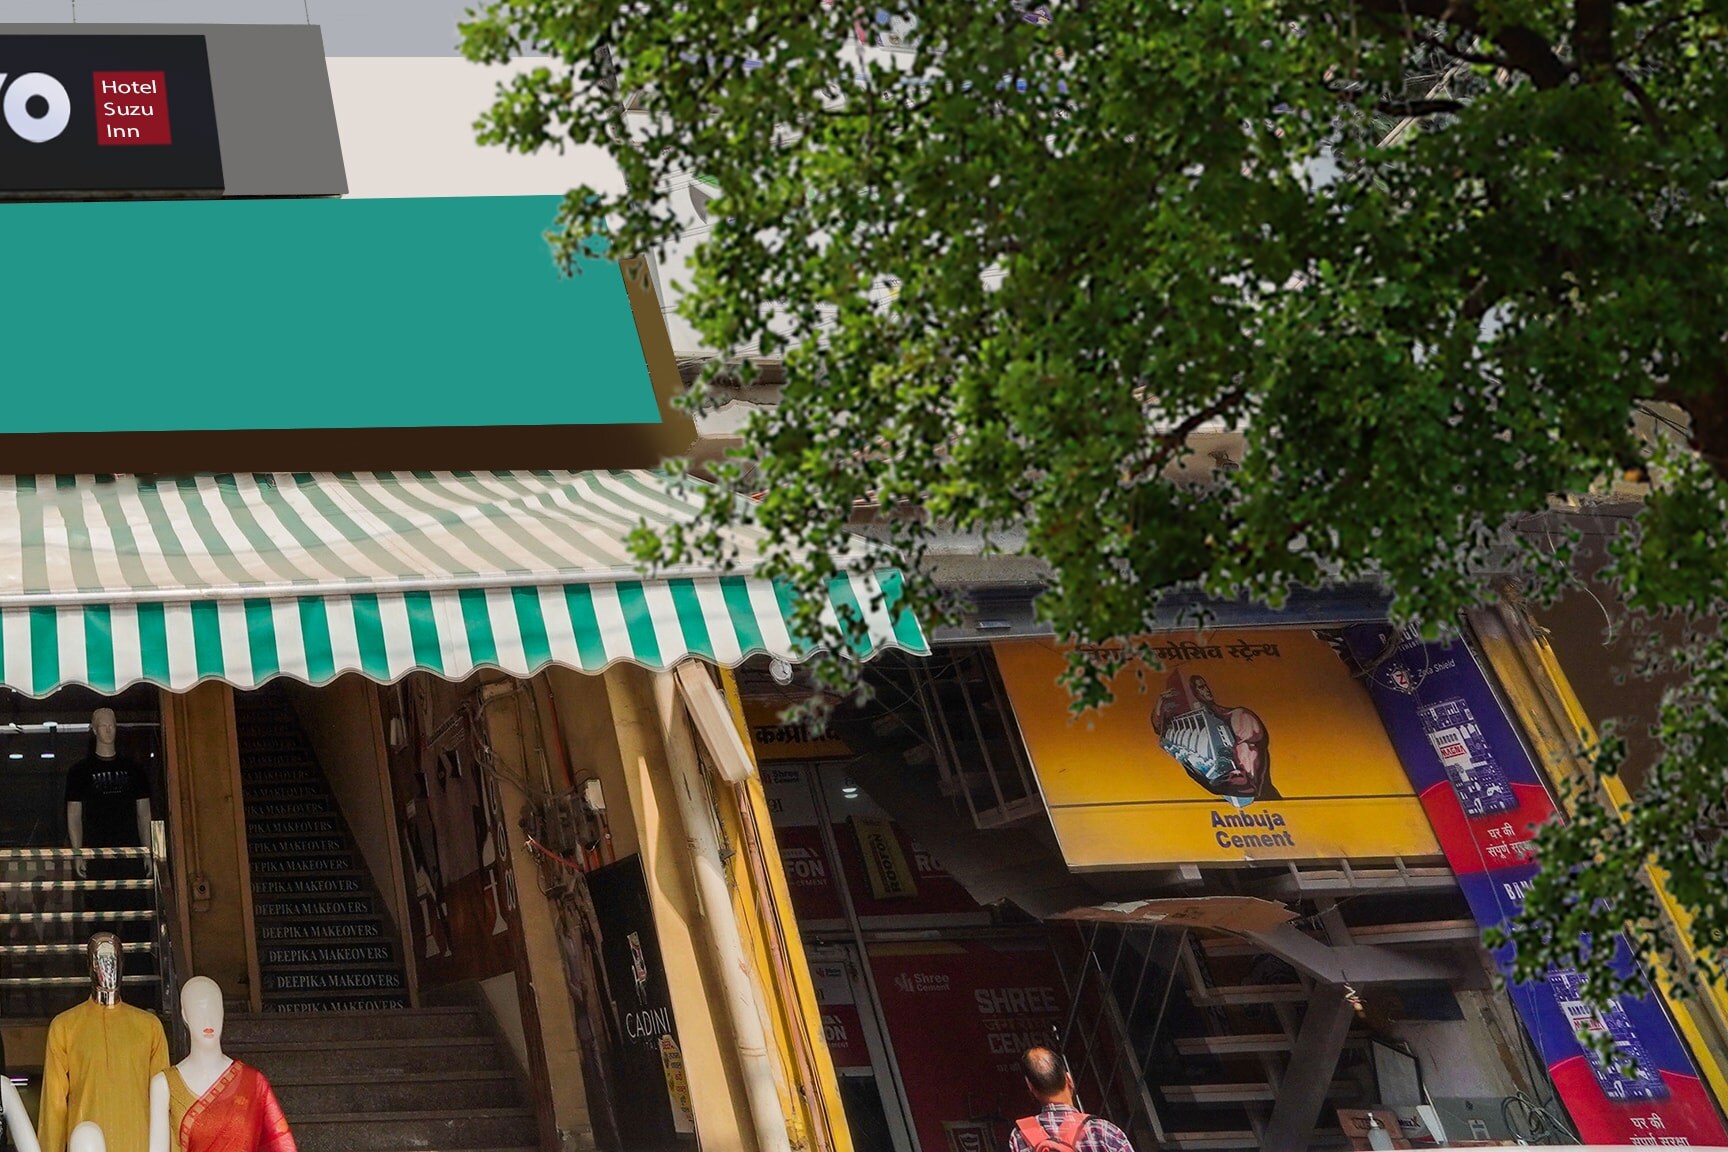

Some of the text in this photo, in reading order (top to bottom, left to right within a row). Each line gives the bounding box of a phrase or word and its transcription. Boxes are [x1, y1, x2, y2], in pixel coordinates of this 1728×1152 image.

[101, 79, 157, 95] Hotel
[103, 101, 155, 117] Suzu
[106, 124, 141, 138] Inn
[1433, 658, 1456, 674] Shield
[272, 821, 333, 832] MAKEOVERS
[1210, 809, 1286, 831] Ambuja
[1487, 821, 1516, 839] घर की
[278, 839, 341, 852] MAKEOVERS
[1216, 830, 1296, 849] Cement
[285, 859, 349, 872] MAKEOVERS
[294, 879, 360, 892] MAKEOVERS
[255, 901, 368, 916] DEEPIKA MAKEOVERS
[262, 924, 379, 939] DEEPIKA MAKEOVERS
[269, 946, 390, 963] DEEPIKA MAKEOVERS
[277, 973, 401, 989] DEEPIKA MAKEOVERS
[913, 973, 950, 986] Shree
[916, 984, 951, 992] Cement
[974, 987, 1063, 1014] SHREE
[625, 1007, 672, 1039] CADINI
[1629, 1112, 1666, 1130] घर की
